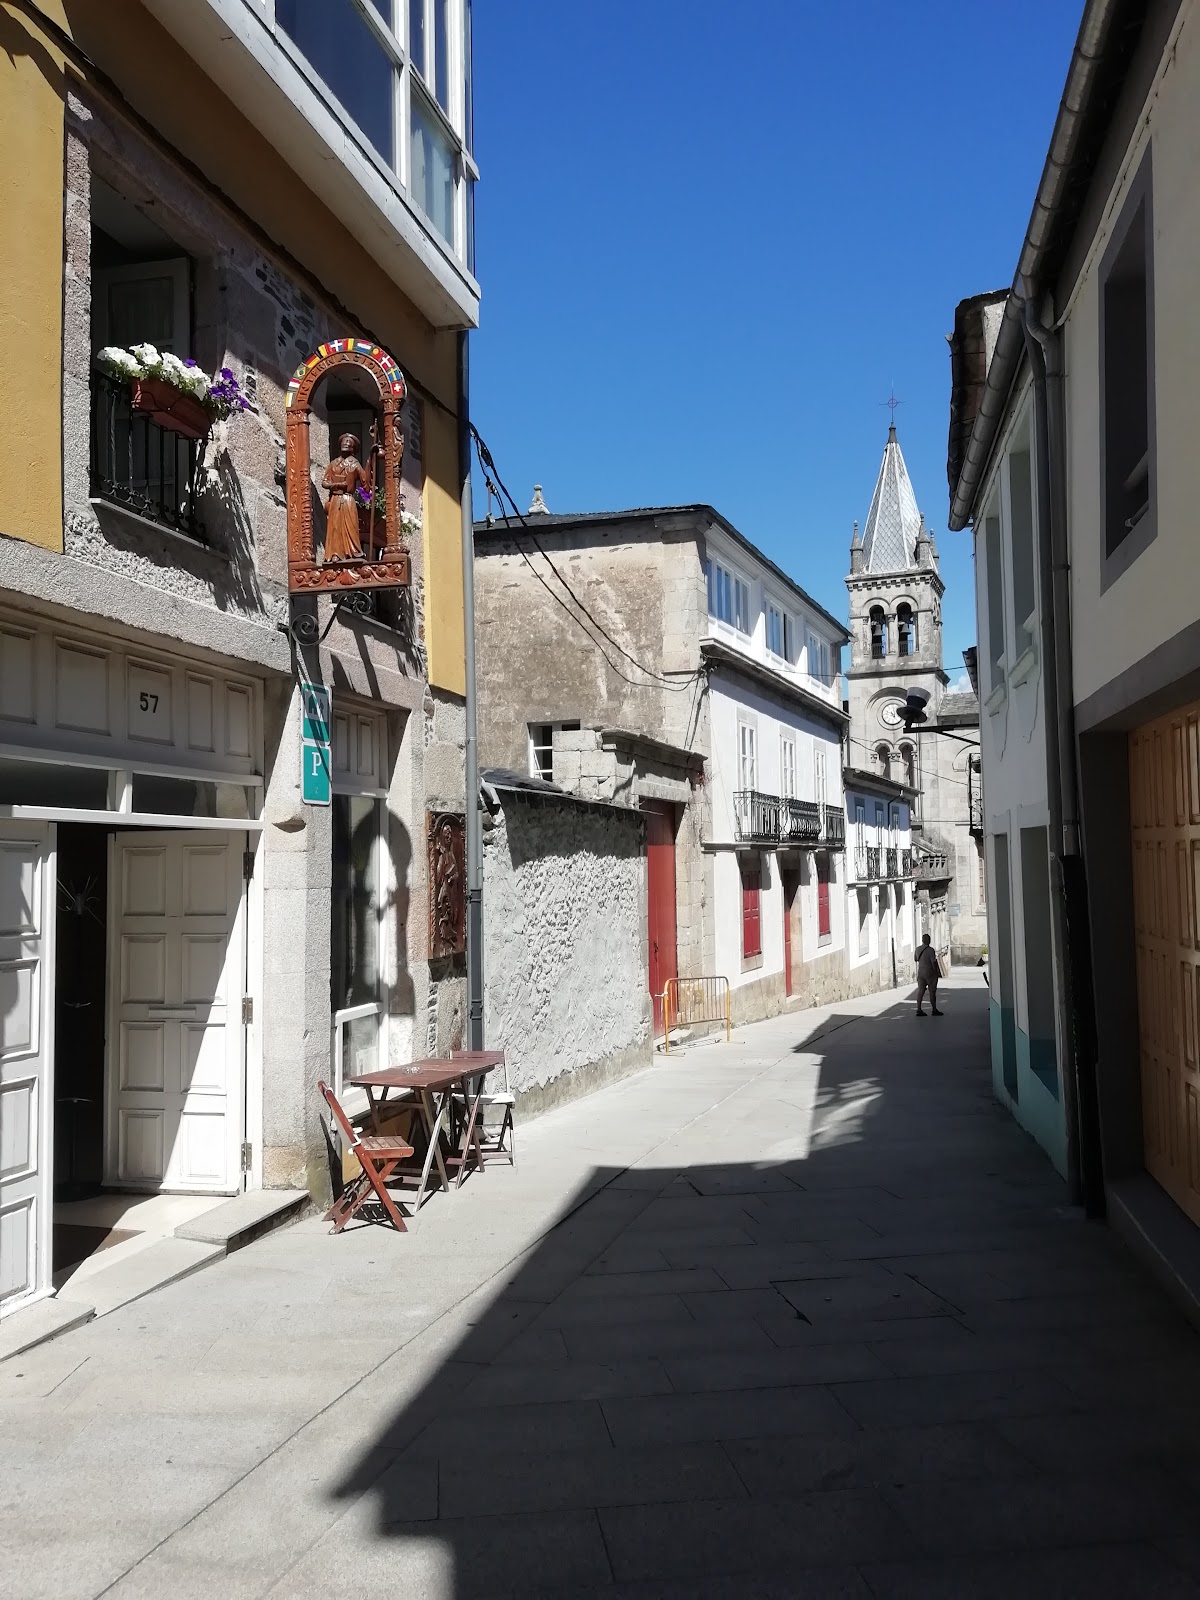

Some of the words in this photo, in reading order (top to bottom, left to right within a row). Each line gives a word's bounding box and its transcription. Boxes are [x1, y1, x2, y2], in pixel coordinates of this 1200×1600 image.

[297, 351, 391, 402] INTERNACIONAL
[300, 469, 312, 551] RESTAURANTE
[140, 692, 159, 714] 57
[311, 751, 322, 776] P
